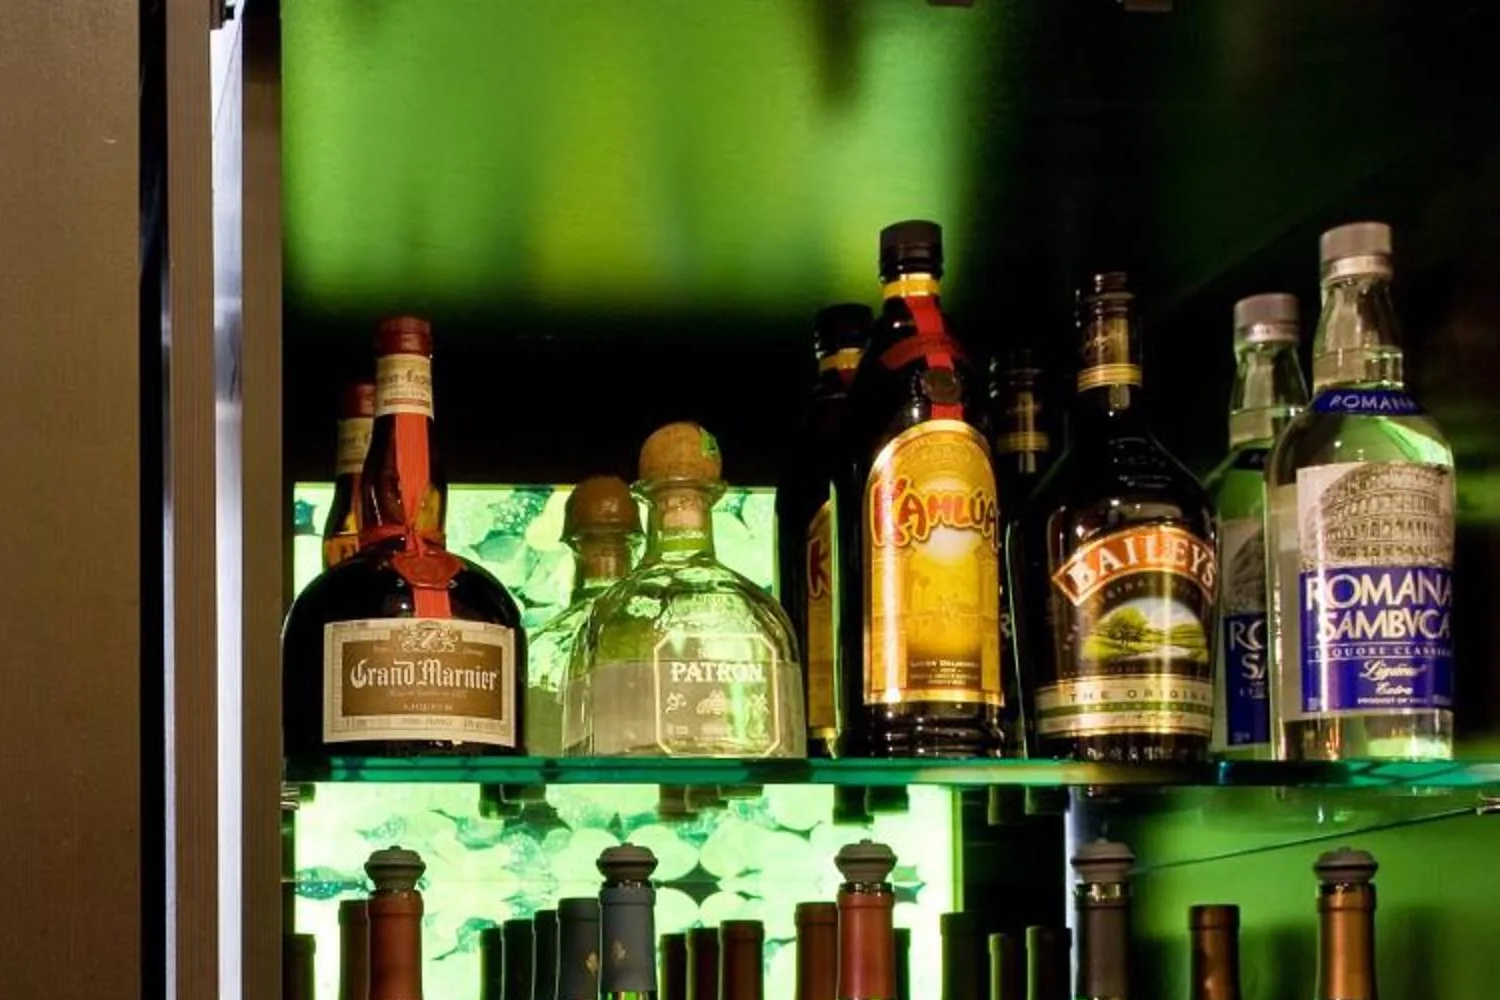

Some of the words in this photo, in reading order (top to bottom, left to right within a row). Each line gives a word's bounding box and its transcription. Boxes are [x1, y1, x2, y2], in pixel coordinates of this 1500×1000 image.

[1329, 394, 1413, 410] ROMAN
[1067, 534, 1218, 593] BAILEYS
[1305, 570, 1451, 611] ROMANA
[1315, 646, 1385, 659] LQUORE
[350, 658, 414, 689] Grand
[415, 658, 498, 691] Marnier
